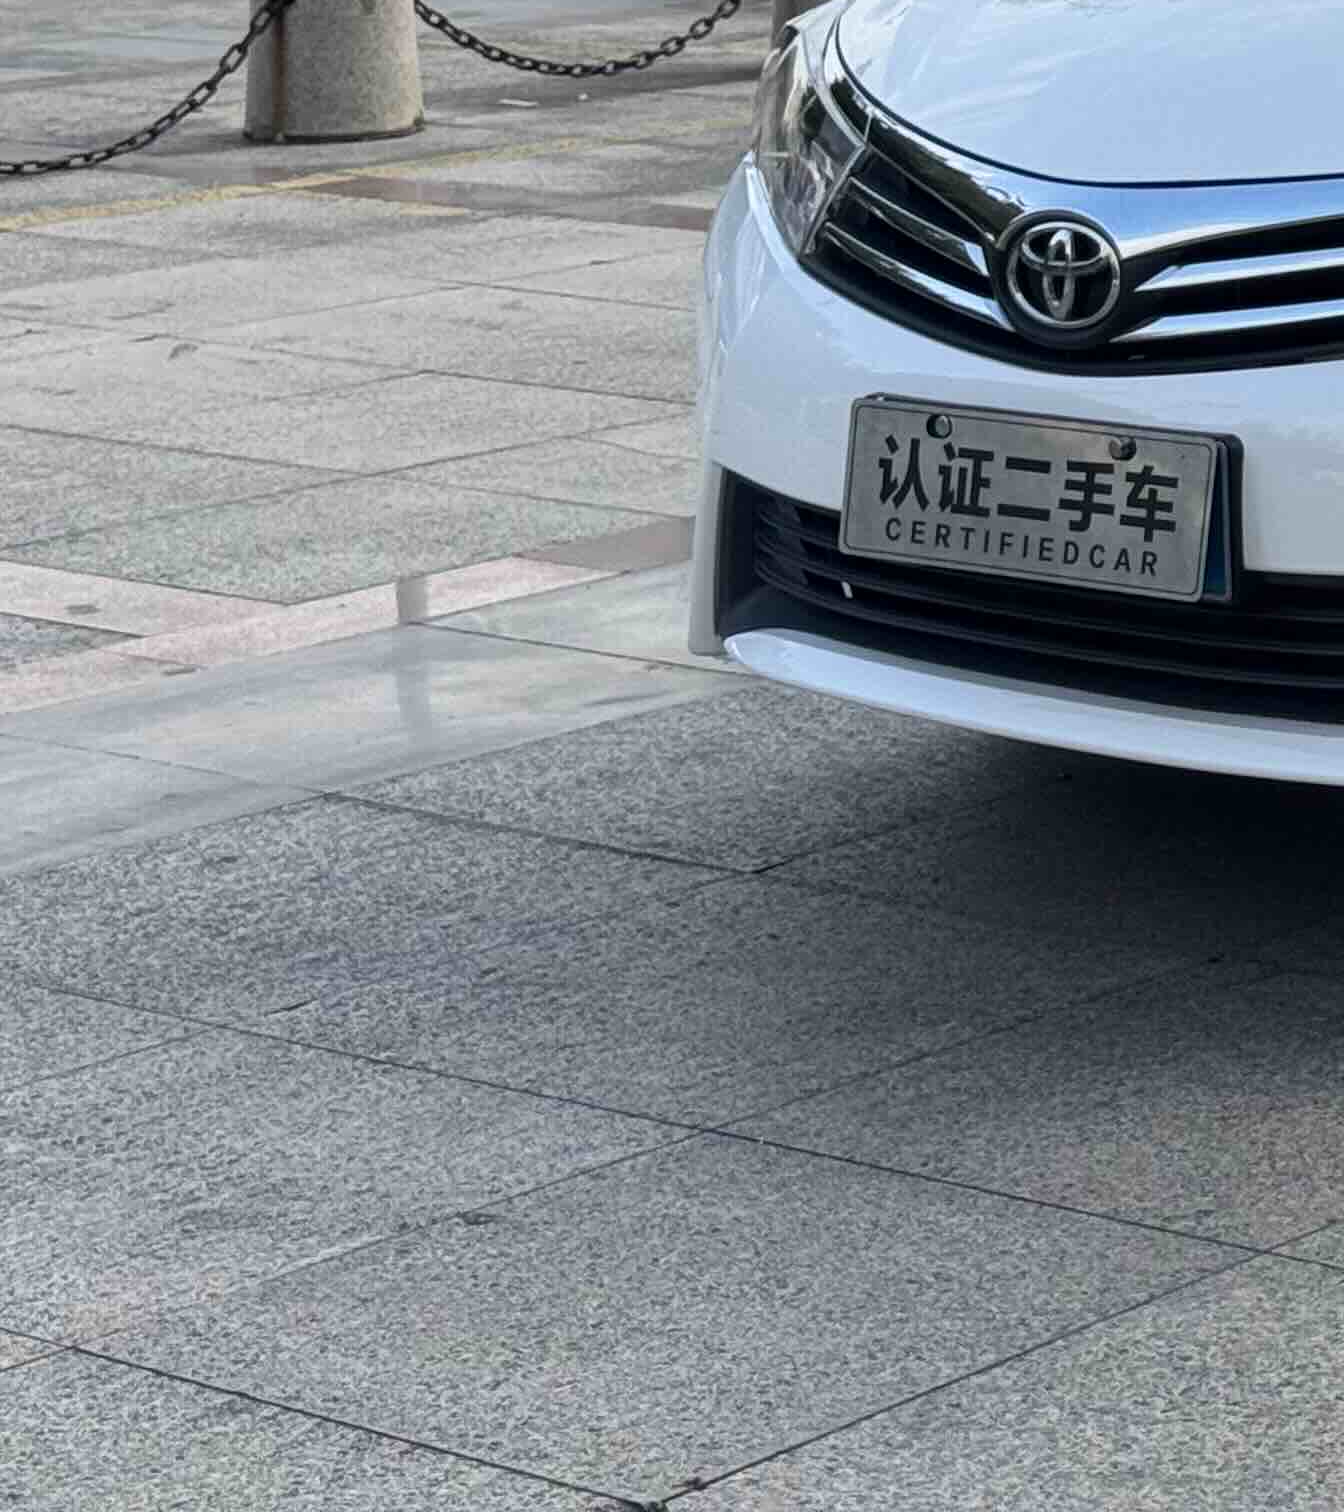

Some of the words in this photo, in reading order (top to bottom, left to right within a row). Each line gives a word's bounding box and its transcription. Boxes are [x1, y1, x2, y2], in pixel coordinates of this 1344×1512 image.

[877, 435, 1180, 543] 认证二手车
[885, 517, 1159, 577] CERTIFIEDCAR
